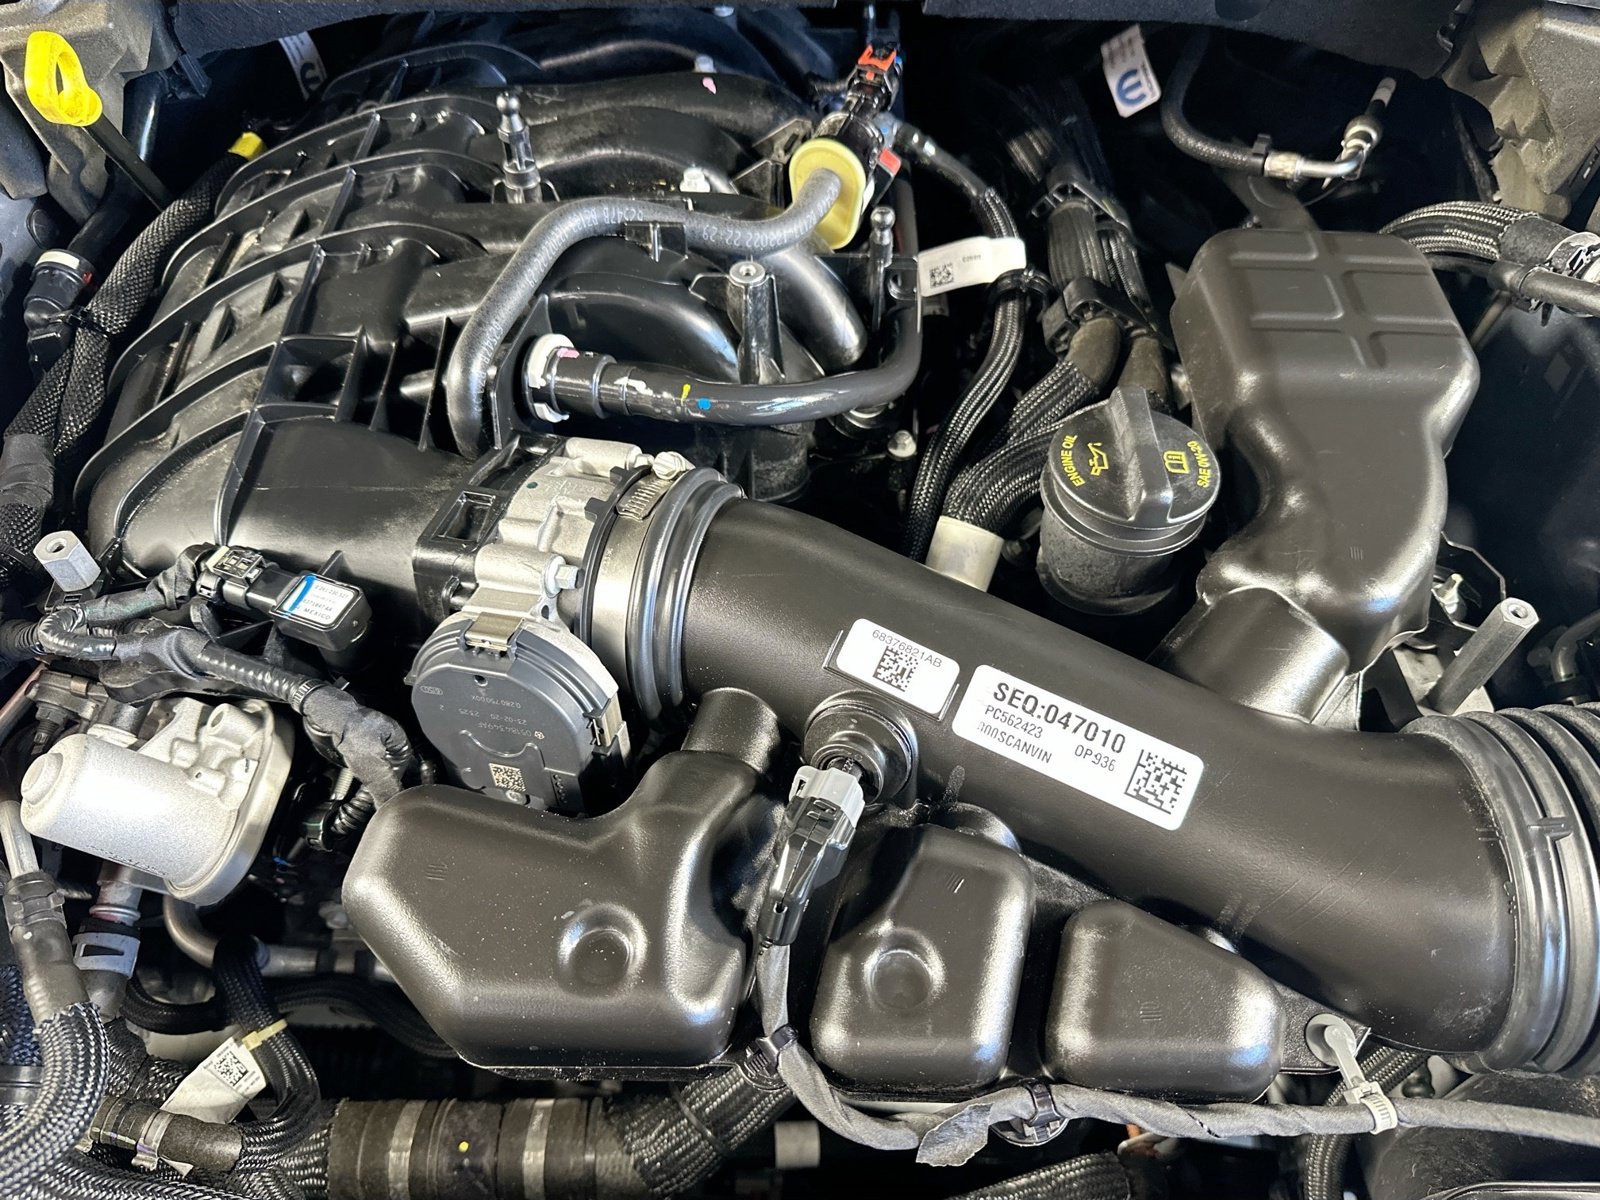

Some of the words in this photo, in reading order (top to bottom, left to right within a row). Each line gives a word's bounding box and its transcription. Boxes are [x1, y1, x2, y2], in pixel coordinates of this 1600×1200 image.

[1062, 435, 1078, 449] OIL
[1187, 440, 1210, 468] 0W-20
[1061, 450, 1085, 487] ENGINE
[1197, 468, 1211, 488] SAE
[303, 608, 331, 620] MEXICO
[871, 629, 943, 668] 68376821AB
[984, 705, 1043, 739] PC562423
[993, 682, 1126, 754] SEQ:047010
